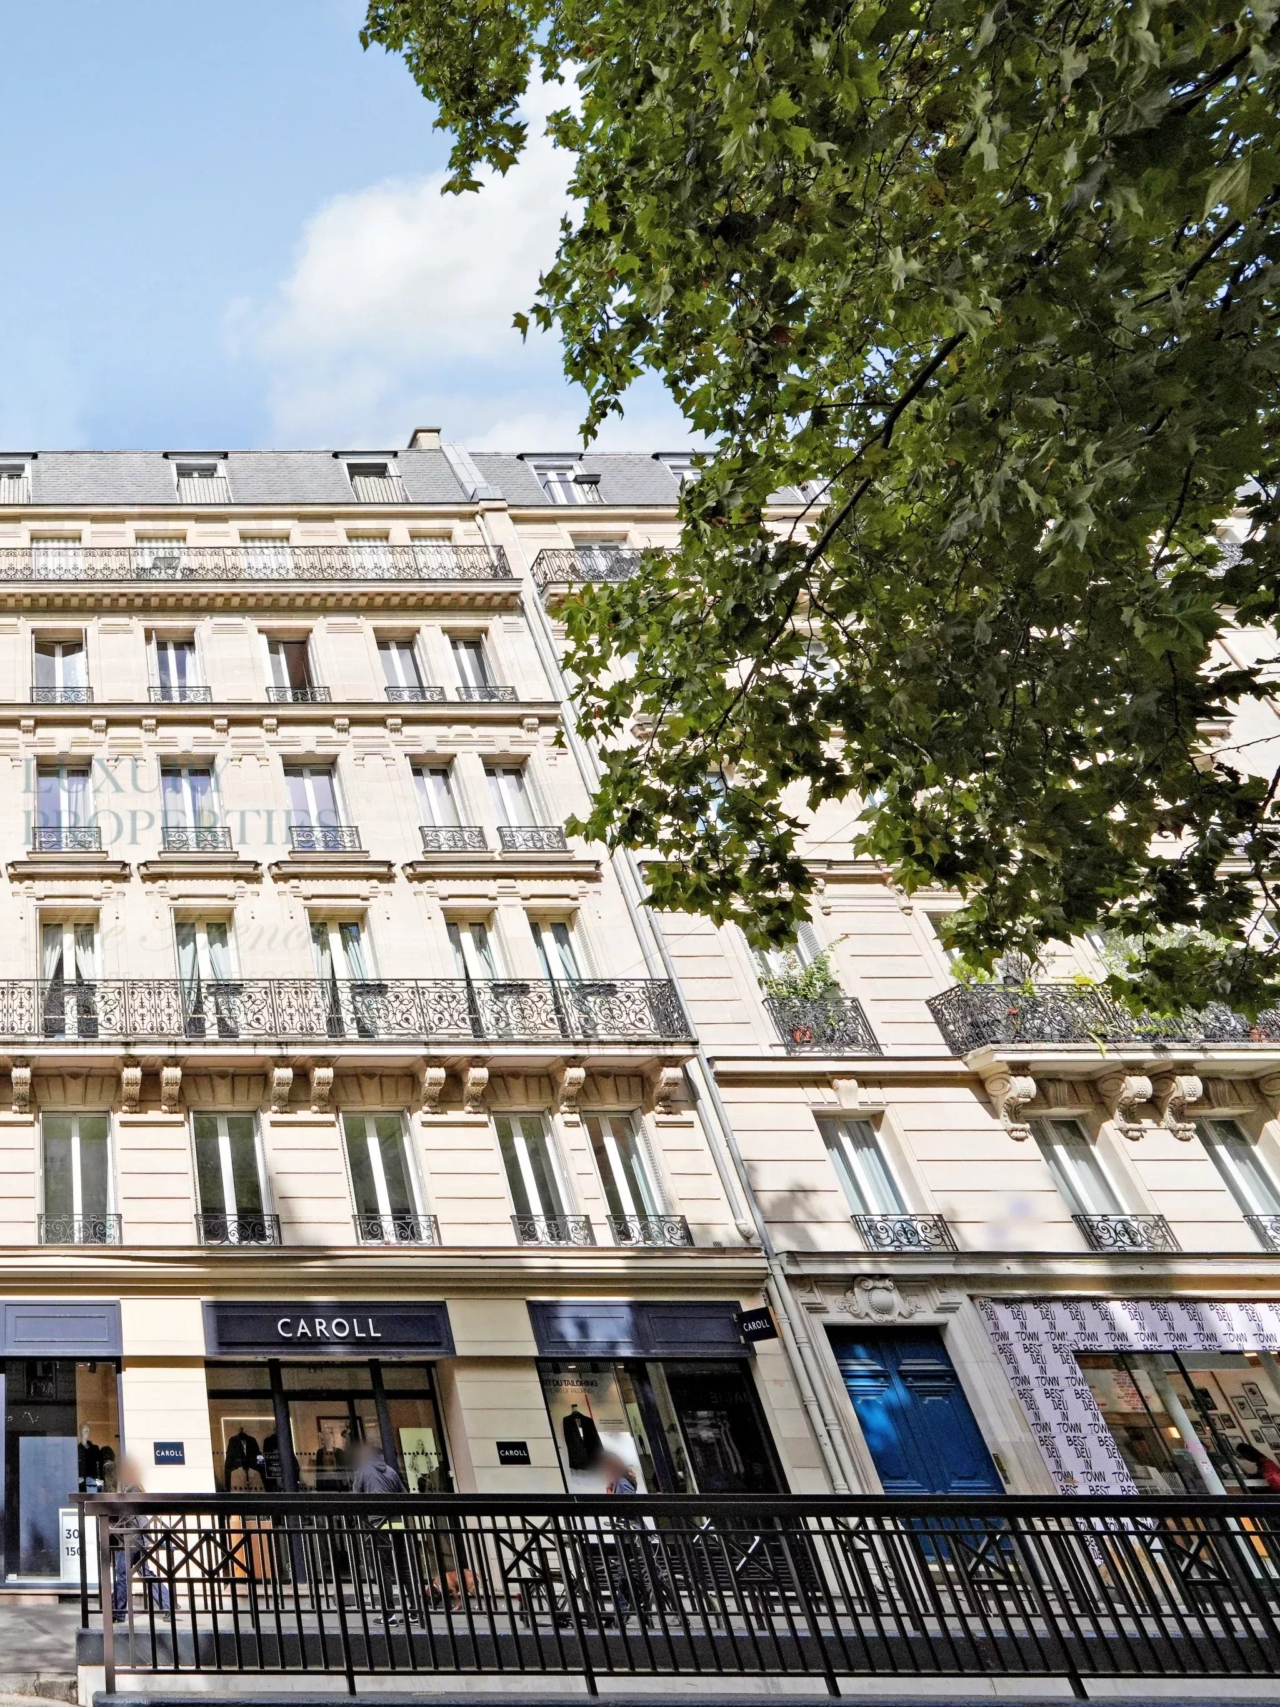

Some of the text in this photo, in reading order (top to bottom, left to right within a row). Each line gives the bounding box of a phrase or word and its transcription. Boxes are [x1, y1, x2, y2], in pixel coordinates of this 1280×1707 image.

[277, 1318, 382, 1337] CAROLL
[743, 1319, 770, 1332] CAROLL
[993, 1322, 1001, 1332] IN
[1020, 1322, 1028, 1332] IN
[1049, 1322, 1057, 1332] IN
[1078, 1322, 1087, 1332] IN
[1107, 1322, 1117, 1332] IN
[1137, 1322, 1146, 1332] IN
[1166, 1322, 1175, 1332] IN
[1196, 1322, 1205, 1332] IN
[1255, 1322, 1265, 1332] IN
[990, 1332, 1010, 1342] TOWN
[1015, 1332, 1040, 1342] TOWN
[1074, 1332, 1099, 1342] TOWN
[1104, 1332, 1129, 1342] TOWN
[1134, 1332, 1158, 1342] TOWN
[1163, 1332, 1188, 1342] TOWN
[1193, 1332, 1218, 1342] TOWN
[1222, 1332, 1248, 1342] TOWN
[1252, 1332, 1278, 1342] TOWN
[997, 1343, 1014, 1354] BEST
[1022, 1343, 1043, 1354] BEST
[1012, 1366, 1020, 1375] IN
[1039, 1366, 1047, 1375] IN
[1068, 1366, 1077, 1375] IN
[1010, 1375, 1031, 1387] TOWN
[1035, 1376, 1060, 1387] TOWN
[1017, 1389, 1034, 1400] BEST
[1044, 1389, 1065, 1400] BEST
[1033, 1411, 1040, 1421] IN
[1060, 1411, 1069, 1421] IN
[1091, 1411, 1100, 1422] IN
[1031, 1422, 1051, 1433] TOWN
[1057, 1422, 1082, 1433] TOWN
[1038, 1436, 1056, 1447] BEST
[1066, 1436, 1087, 1447] BEST
[1097, 1436, 1116, 1447] BES
[1054, 1459, 1062, 1470] IN
[1084, 1459, 1093, 1470] IN
[1115, 1460, 1124, 1470] IN
[1052, 1471, 1074, 1482] TOWN
[1080, 1471, 1106, 1482] TOWN
[1112, 1472, 1134, 1483] TOW
[1088, 1485, 1110, 1495] BEST
[1120, 1485, 1139, 1495] BES
